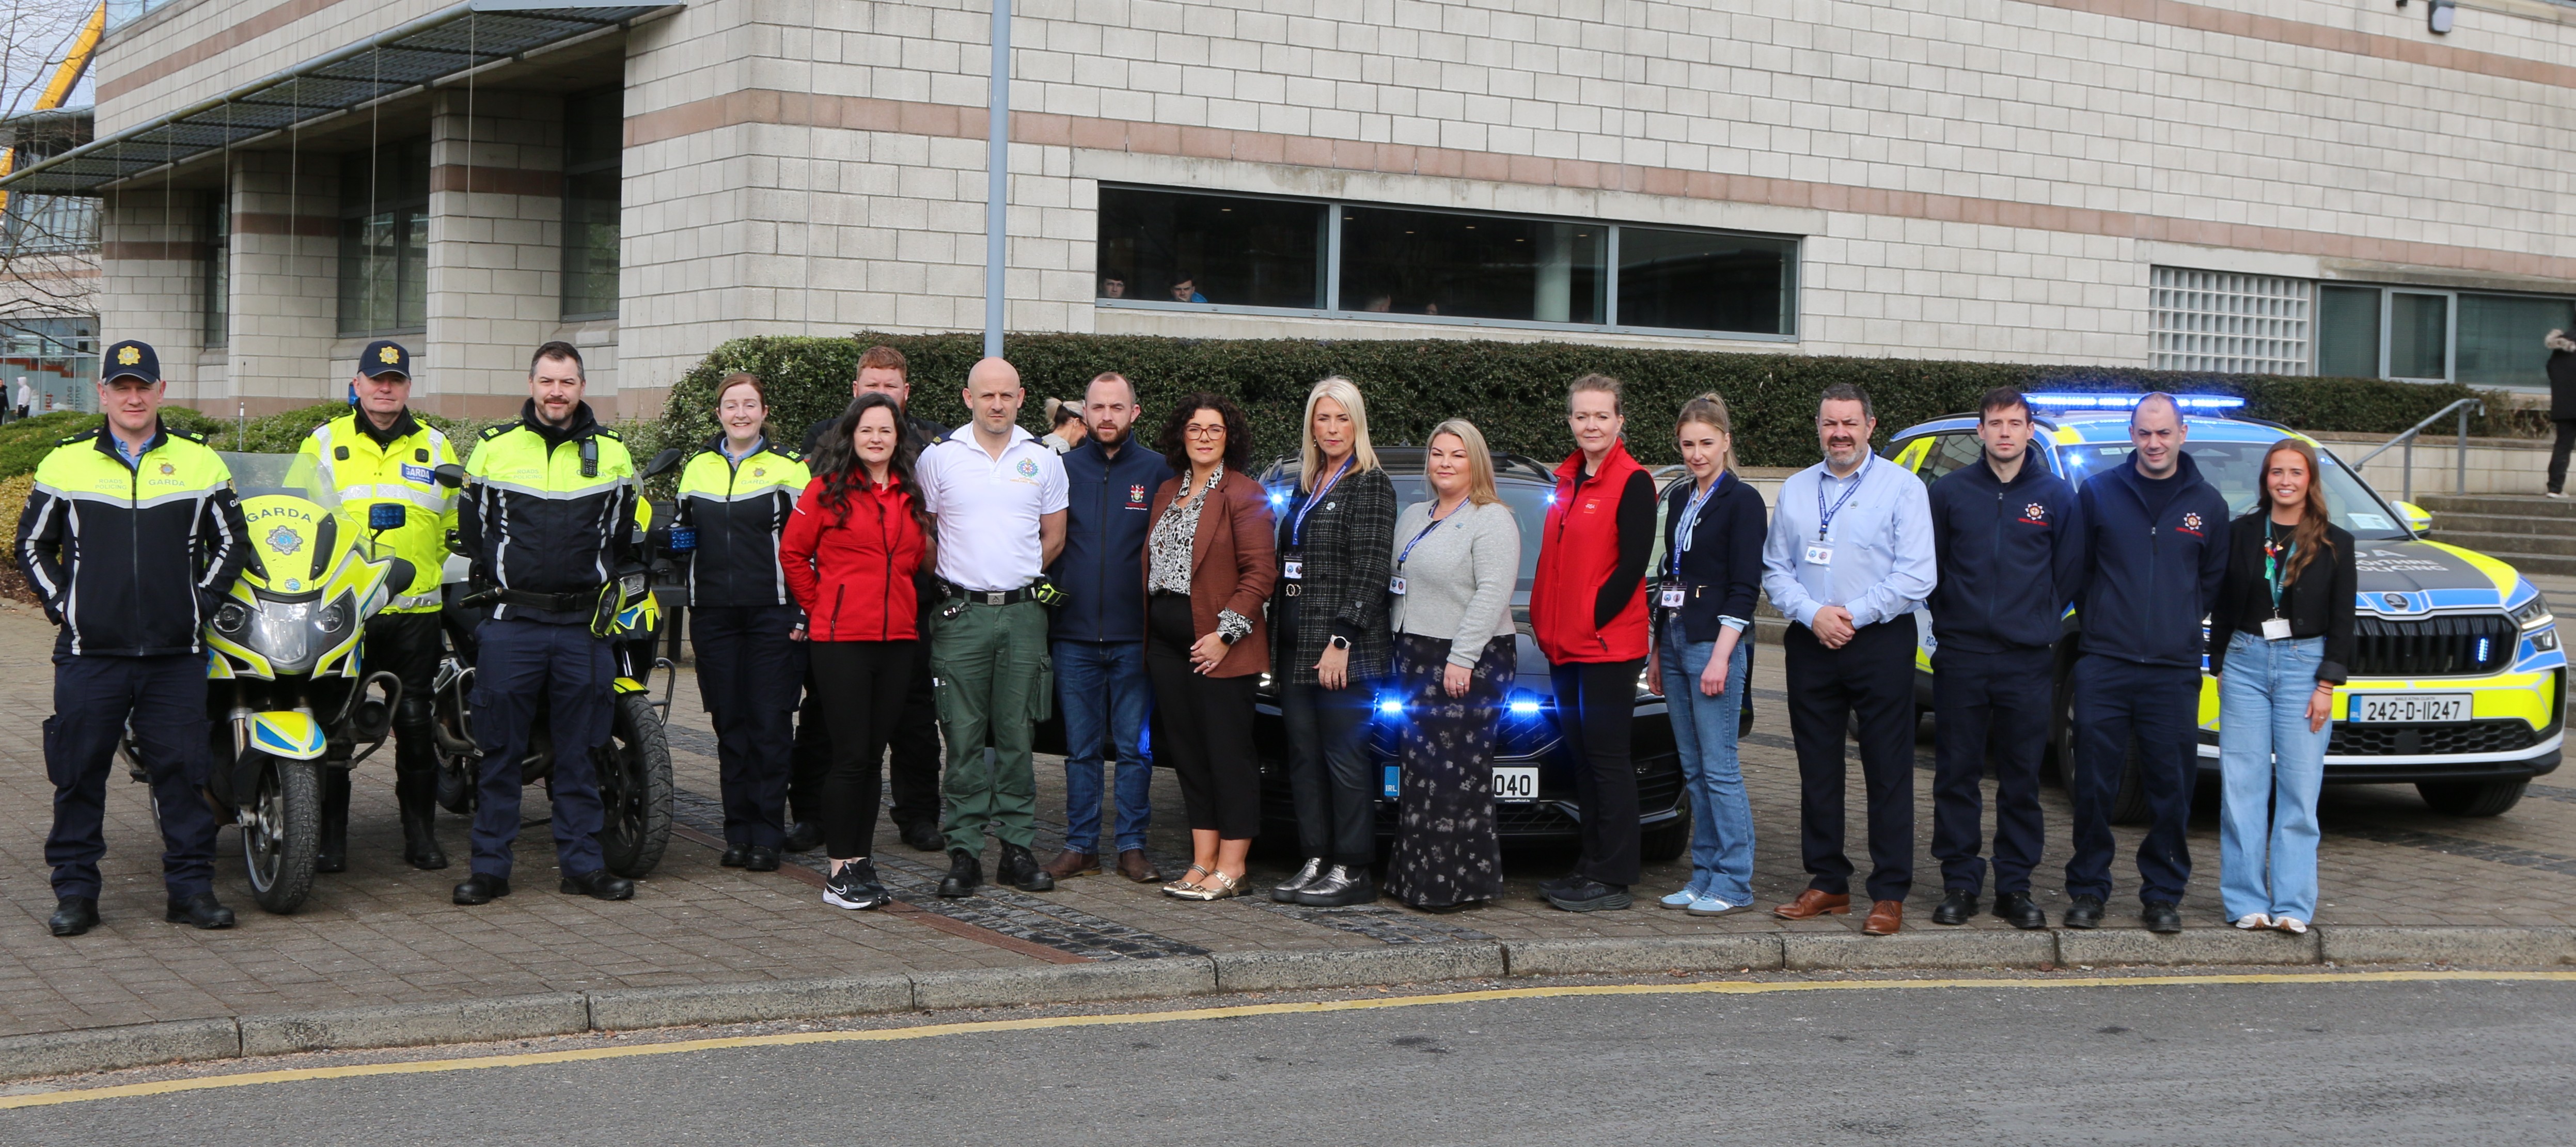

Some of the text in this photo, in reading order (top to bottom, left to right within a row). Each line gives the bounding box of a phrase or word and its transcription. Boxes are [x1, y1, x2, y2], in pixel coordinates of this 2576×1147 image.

[405, 467, 430, 479] GARDA
[246, 507, 311, 523] GARDA
[1925, 636, 1937, 648] ROA
[2367, 701, 2460, 720] 242-D-11247
